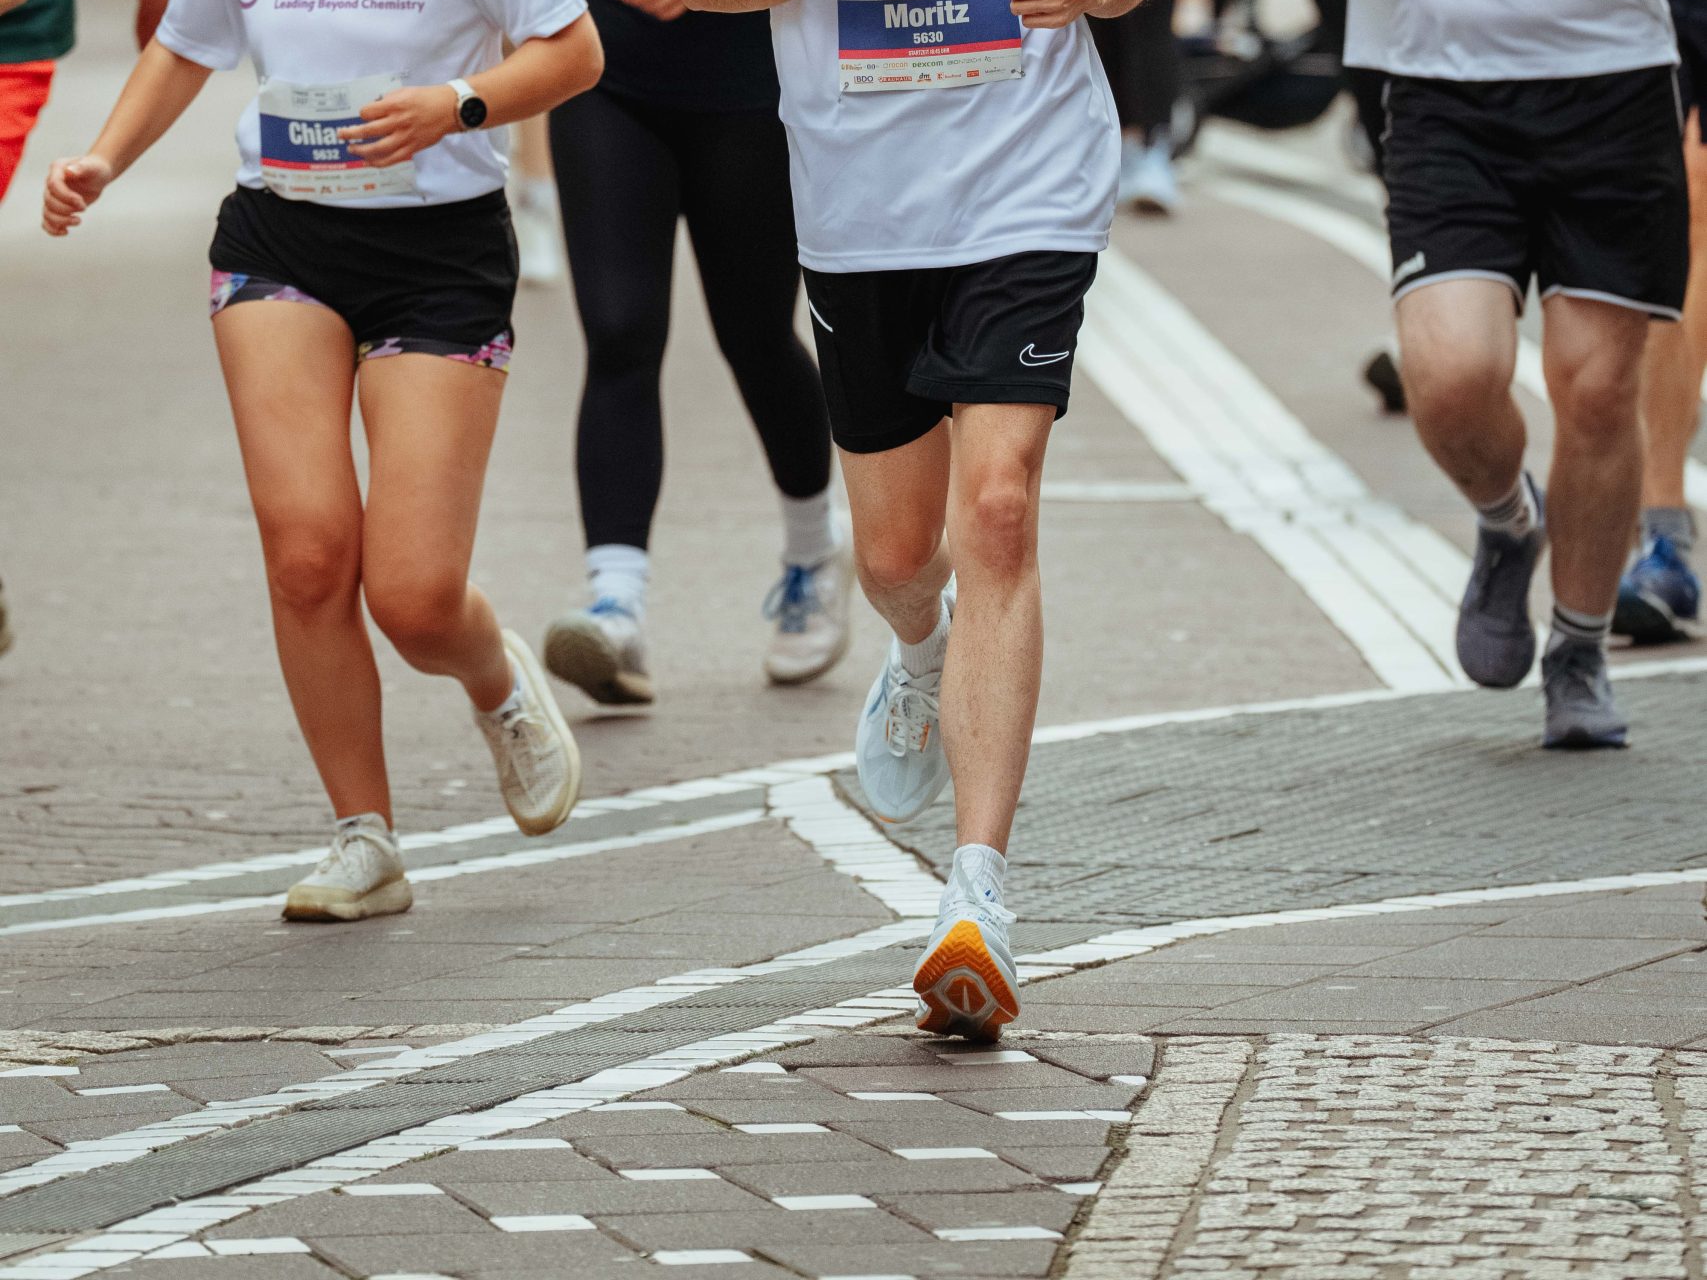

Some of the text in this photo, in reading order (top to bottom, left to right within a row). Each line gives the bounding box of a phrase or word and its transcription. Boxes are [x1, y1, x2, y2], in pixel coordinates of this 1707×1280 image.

[884, 0, 970, 29] Moritz
[913, 31, 944, 44] 5630
[288, 121, 364, 146] Chia
